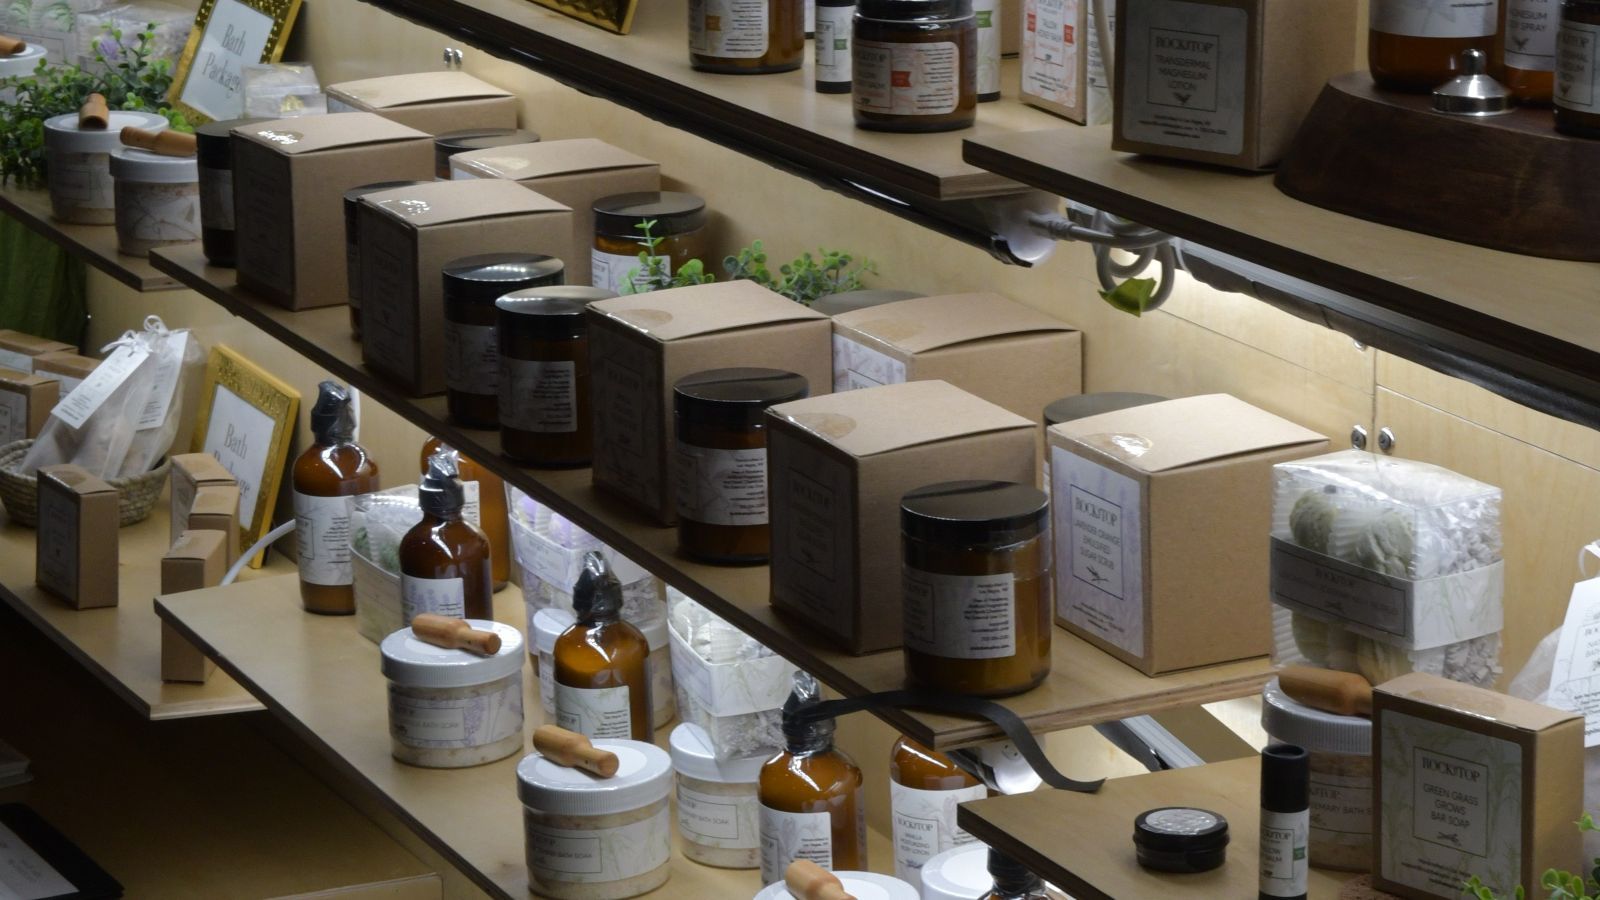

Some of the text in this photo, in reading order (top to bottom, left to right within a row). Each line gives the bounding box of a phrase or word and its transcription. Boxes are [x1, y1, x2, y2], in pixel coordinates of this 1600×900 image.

[222, 23, 247, 57] Bath
[223, 423, 248, 460] Bath
[1423, 783, 1479, 807] GREEN GRASS
[1431, 810, 1471, 829] BAR SOAP
[1434, 799, 1467, 816] GROWS
